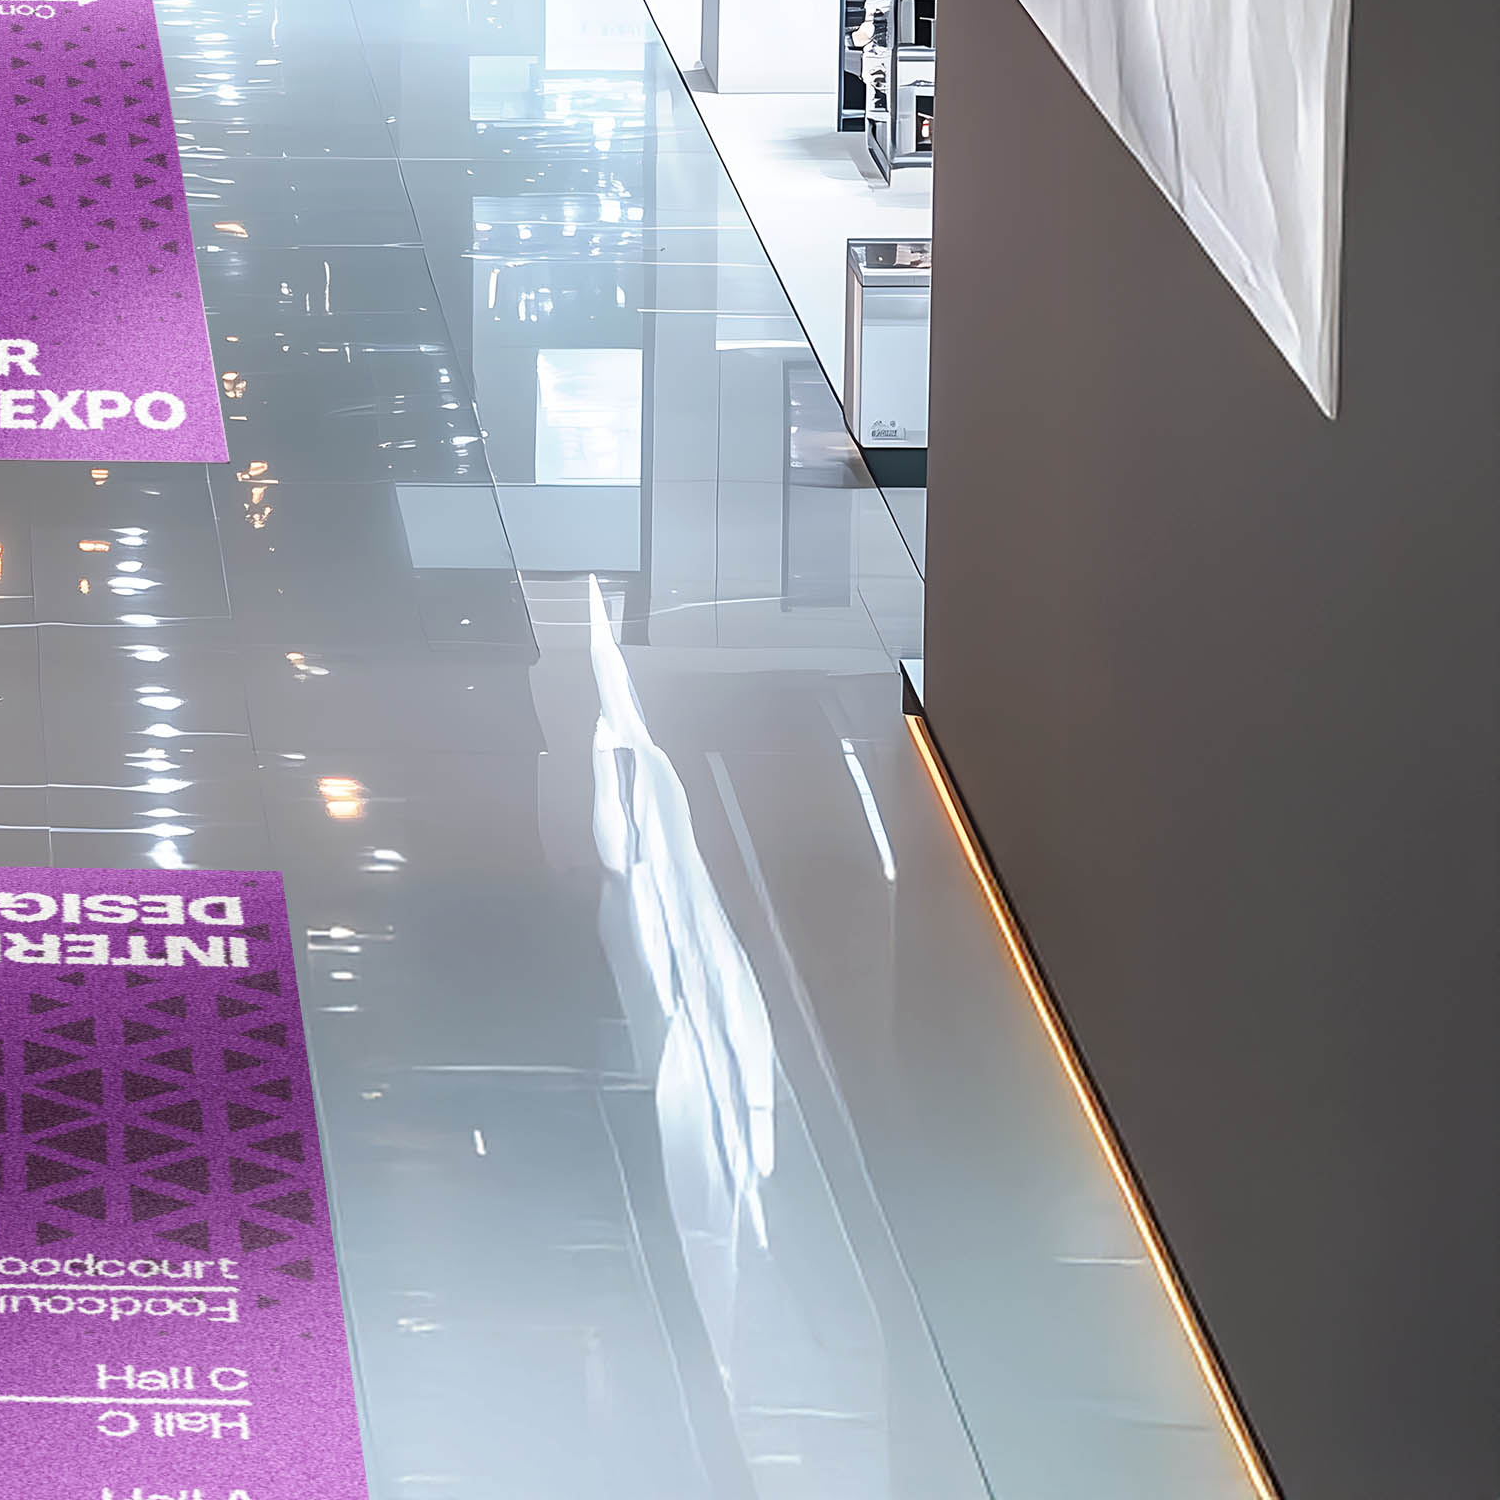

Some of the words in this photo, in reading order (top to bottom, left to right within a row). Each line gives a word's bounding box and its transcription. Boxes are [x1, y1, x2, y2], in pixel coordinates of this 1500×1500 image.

[96, 1363, 195, 1391] Hall
[207, 1367, 249, 1392] C
[96, 1409, 140, 1438] C
[152, 1411, 252, 1440] Hall
